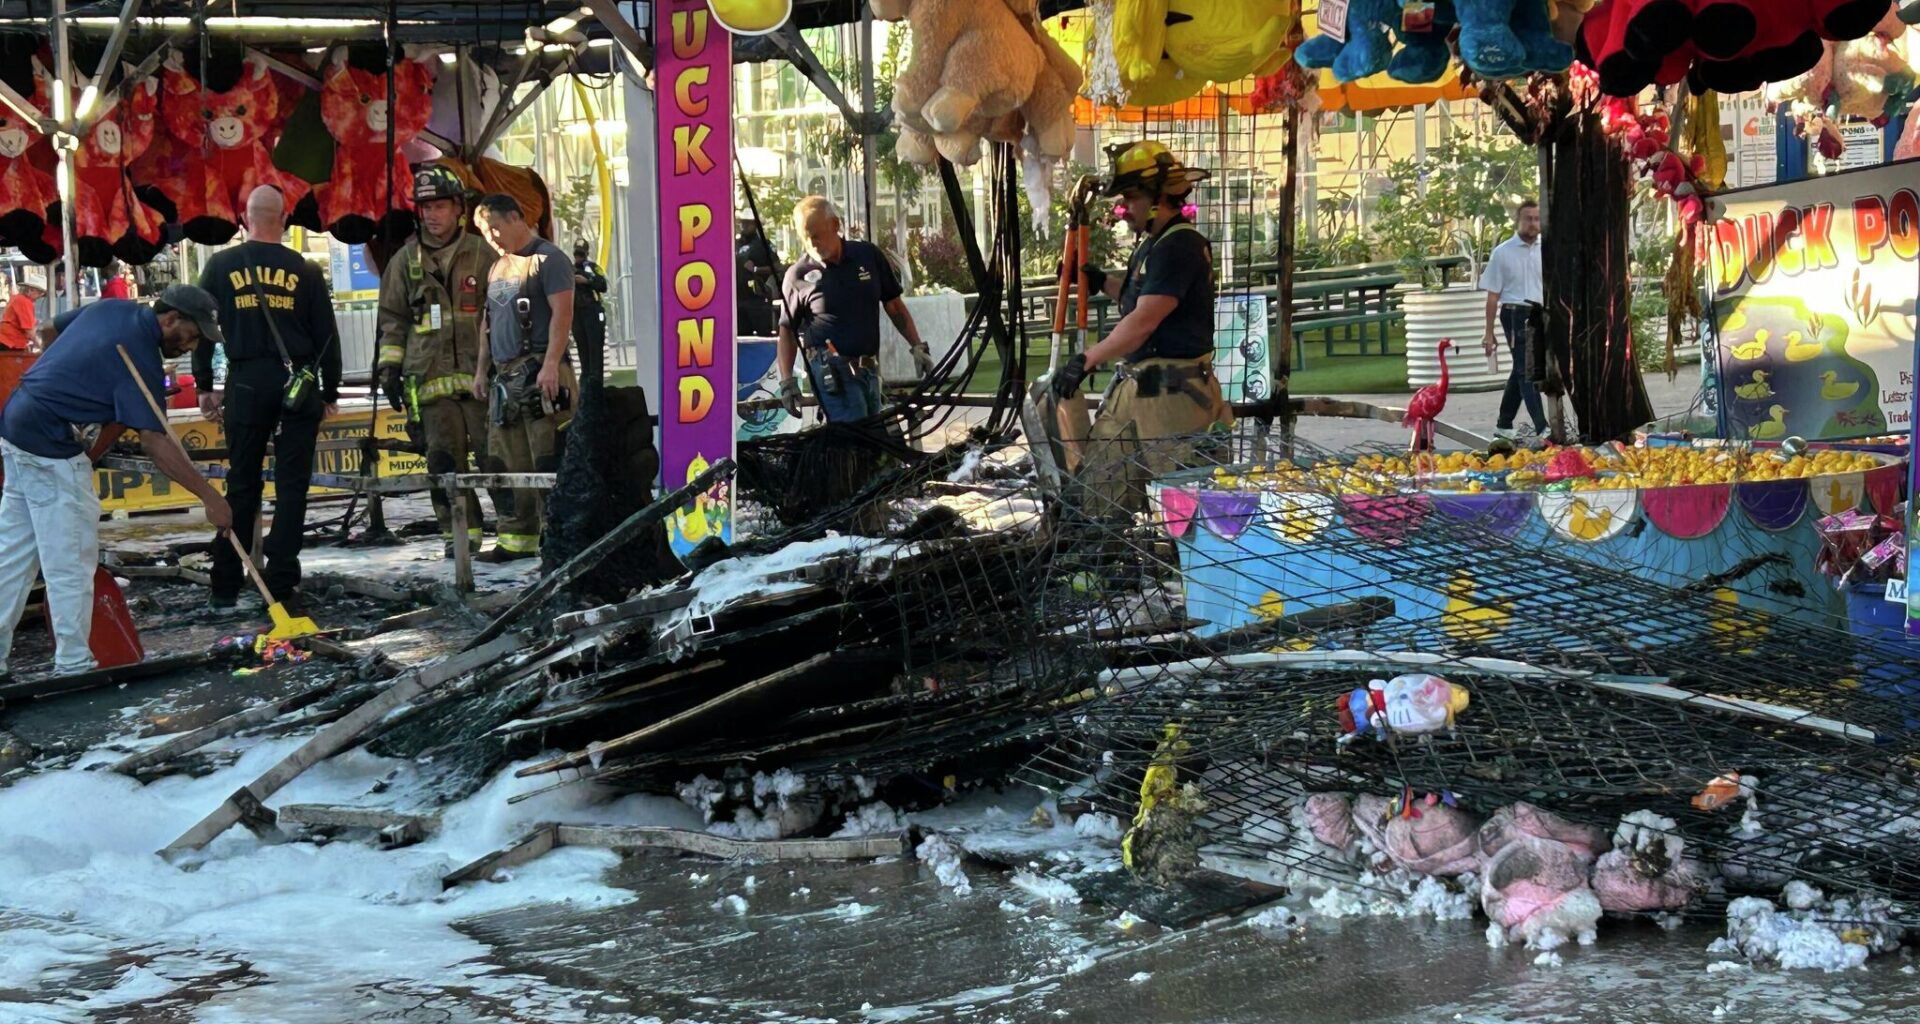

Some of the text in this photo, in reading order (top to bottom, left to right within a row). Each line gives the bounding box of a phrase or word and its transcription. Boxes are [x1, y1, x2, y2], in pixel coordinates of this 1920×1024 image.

[672, 0, 717, 425] UCK POND
[1712, 201, 1839, 294] DUCK
